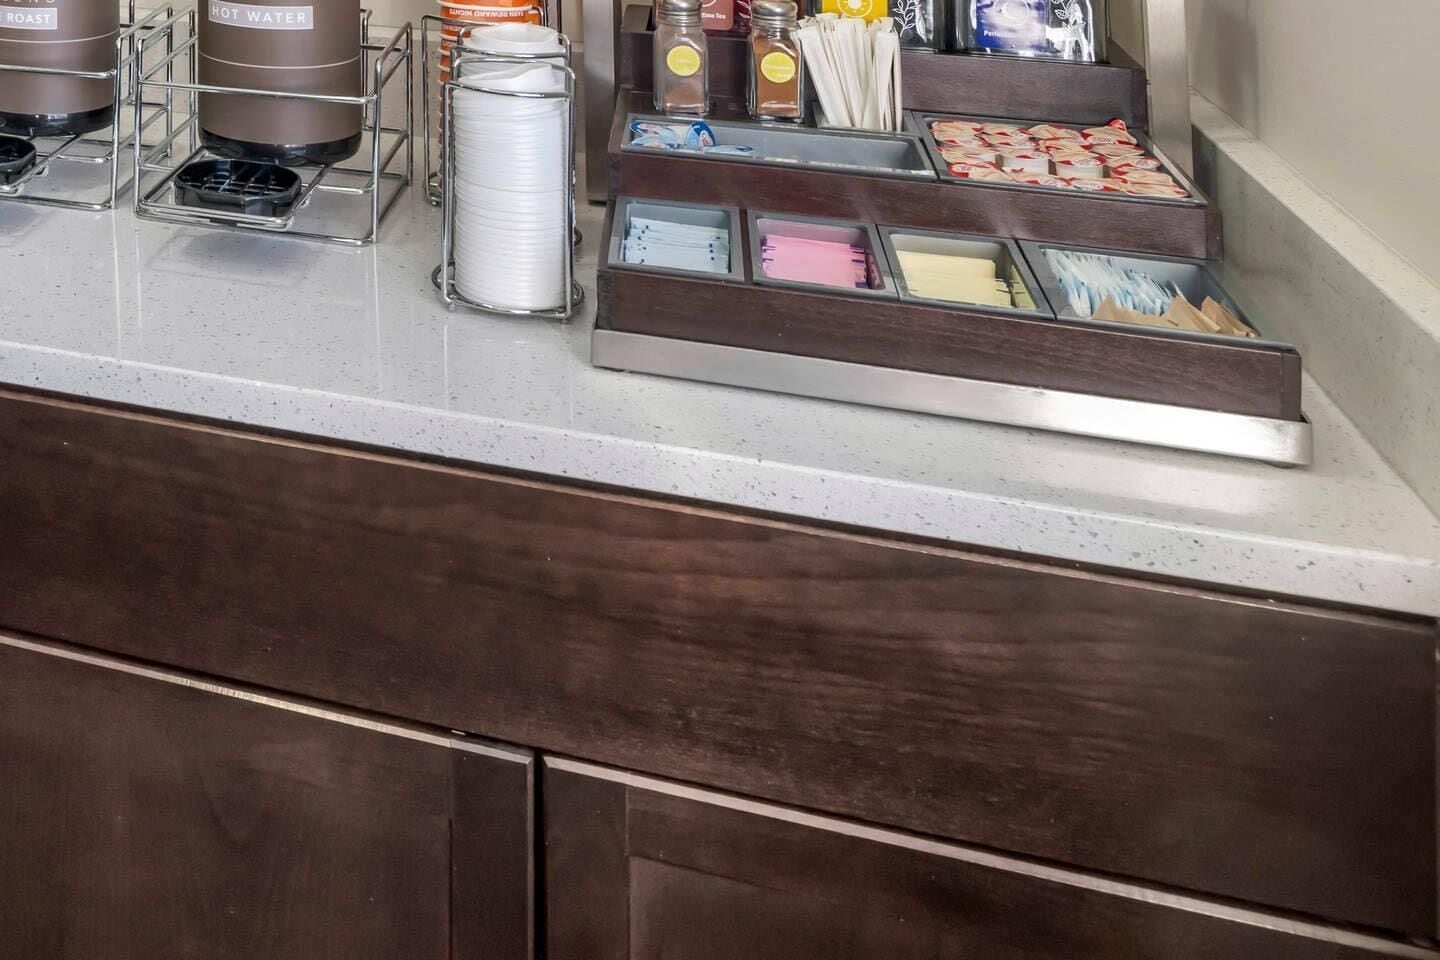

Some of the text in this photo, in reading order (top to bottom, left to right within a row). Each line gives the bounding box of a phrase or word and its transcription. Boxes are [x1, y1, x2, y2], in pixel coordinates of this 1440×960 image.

[7, 13, 51, 24] ROAST
[212, 6, 305, 23] HOT WATER
[474, 10, 508, 18] REWARD
